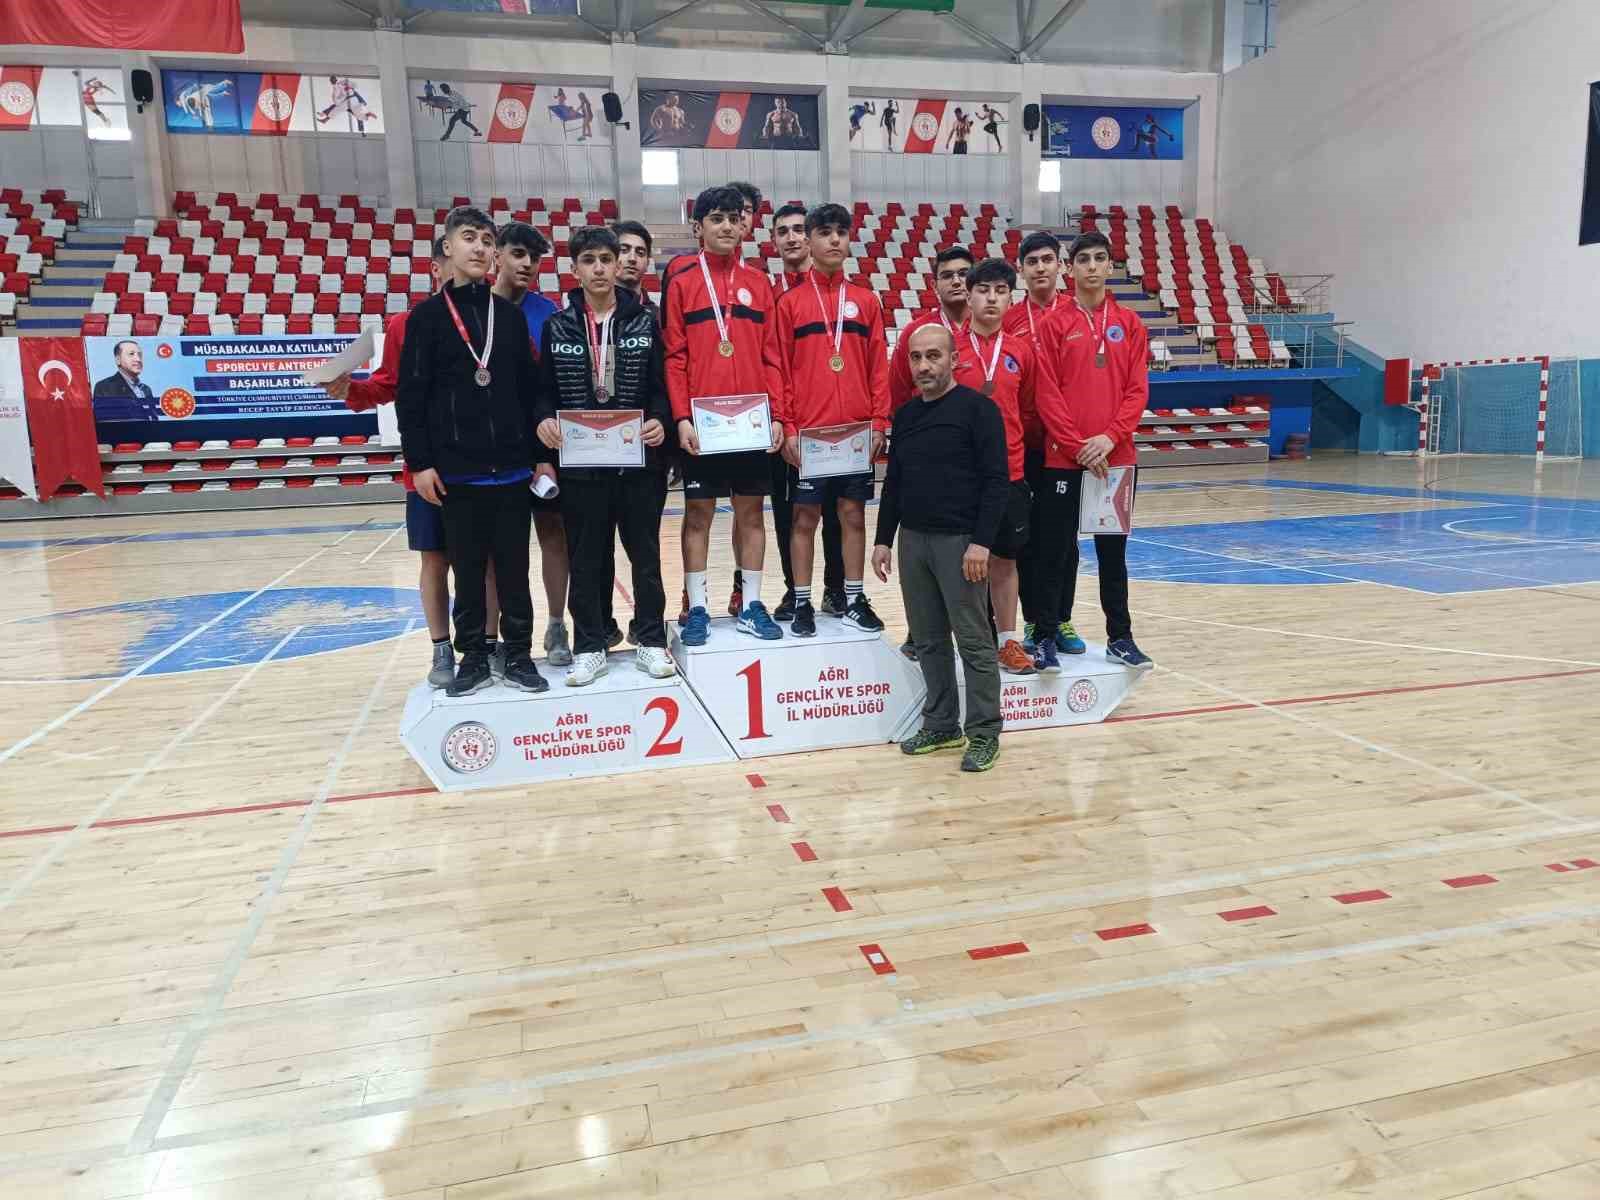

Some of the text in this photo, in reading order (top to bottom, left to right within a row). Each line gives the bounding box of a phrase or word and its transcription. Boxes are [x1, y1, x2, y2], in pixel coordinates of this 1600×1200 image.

[194, 343, 285, 355] MÜSABAKALARA
[286, 343, 332, 353] KATILAN
[551, 343, 584, 355] UGO
[216, 362, 260, 372] SPORCU
[262, 361, 276, 371] VE
[229, 379, 290, 389] BAŞARILAR
[1056, 480, 1068, 494] 15
[818, 666, 848, 682] AĞRI
[776, 683, 891, 704] GENÇLİK VE SPOR
[1003, 686, 1026, 696] AĞRI
[736, 658, 773, 740] 1
[1018, 699, 1030, 707] VE
[1032, 696, 1058, 706] SPOR
[787, 698, 884, 721] İL MÜDÜRLÜĞÜ
[556, 713, 588, 727] AĞRI
[643, 696, 684, 757] 2
[513, 725, 631, 746] GENÇLİK VE SPOR
[524, 738, 625, 760] İL MÜDÜRLÜĞÜ
